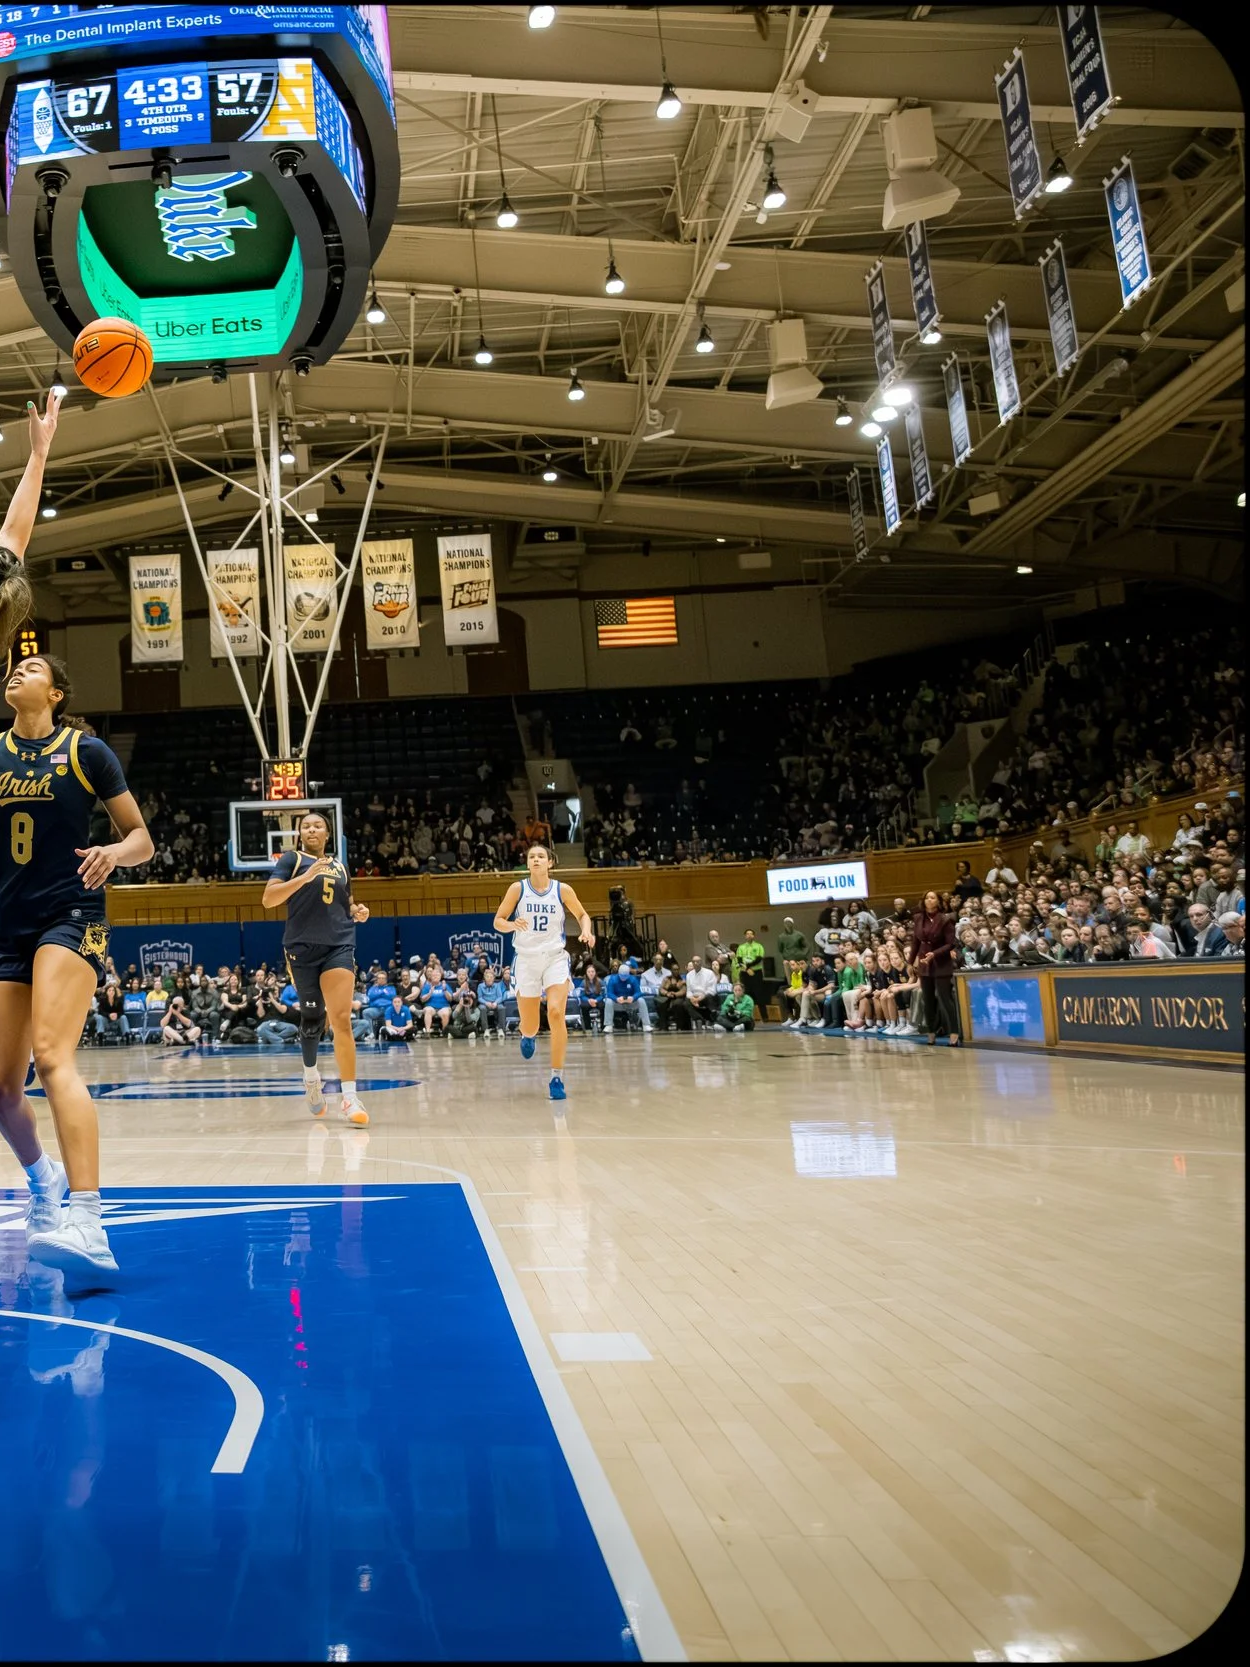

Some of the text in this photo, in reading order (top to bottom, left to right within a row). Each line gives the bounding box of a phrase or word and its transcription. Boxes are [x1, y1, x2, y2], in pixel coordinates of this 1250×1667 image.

[6, 10, 22, 23] 18
[30, 7, 40, 18] 7
[24, 14, 222, 46] The Dental Implant Experts
[273, 21, 335, 29] omsanc.com
[123, 75, 203, 106] 4:33
[216, 72, 263, 104] 57
[67, 84, 112, 118] 67
[141, 104, 188, 116] 4TH QTR
[216, 106, 260, 117] Fouls: 4
[124, 112, 205, 128] 3 TIMEOUTS 2
[73, 121, 113, 134] Fouls: 1
[151, 125, 179, 135] POSS
[155, 317, 263, 339] Uber Eats
[368, 552, 407, 564] NATIONAL
[446, 548, 485, 560] NATIONAL
[365, 564, 413, 576] CHAMPIONS
[444, 559, 491, 572] CHAMPIONS
[137, 567, 175, 578] NATIONAL
[215, 573, 257, 585] HAMPIONS
[133, 579, 179, 590] CHAMPIONS
[381, 625, 406, 636] 2010
[459, 620, 484, 632] 2015
[302, 630, 326, 640] 2001
[20, 641, 39, 656] 57
[147, 639, 169, 649] 1991
[273, 762, 303, 777] 4:33
[271, 776, 299, 799] 25
[10, 812, 35, 865] 8
[778, 874, 856, 892] FOOD LION
[321, 877, 336, 905] 5
[526, 903, 557, 915] DUKE
[532, 915, 549, 932] 12
[144, 951, 189, 964] SISTERHOOD
[1062, 995, 1143, 1027] CAMERON
[1151, 995, 1230, 1031] INDOOR
